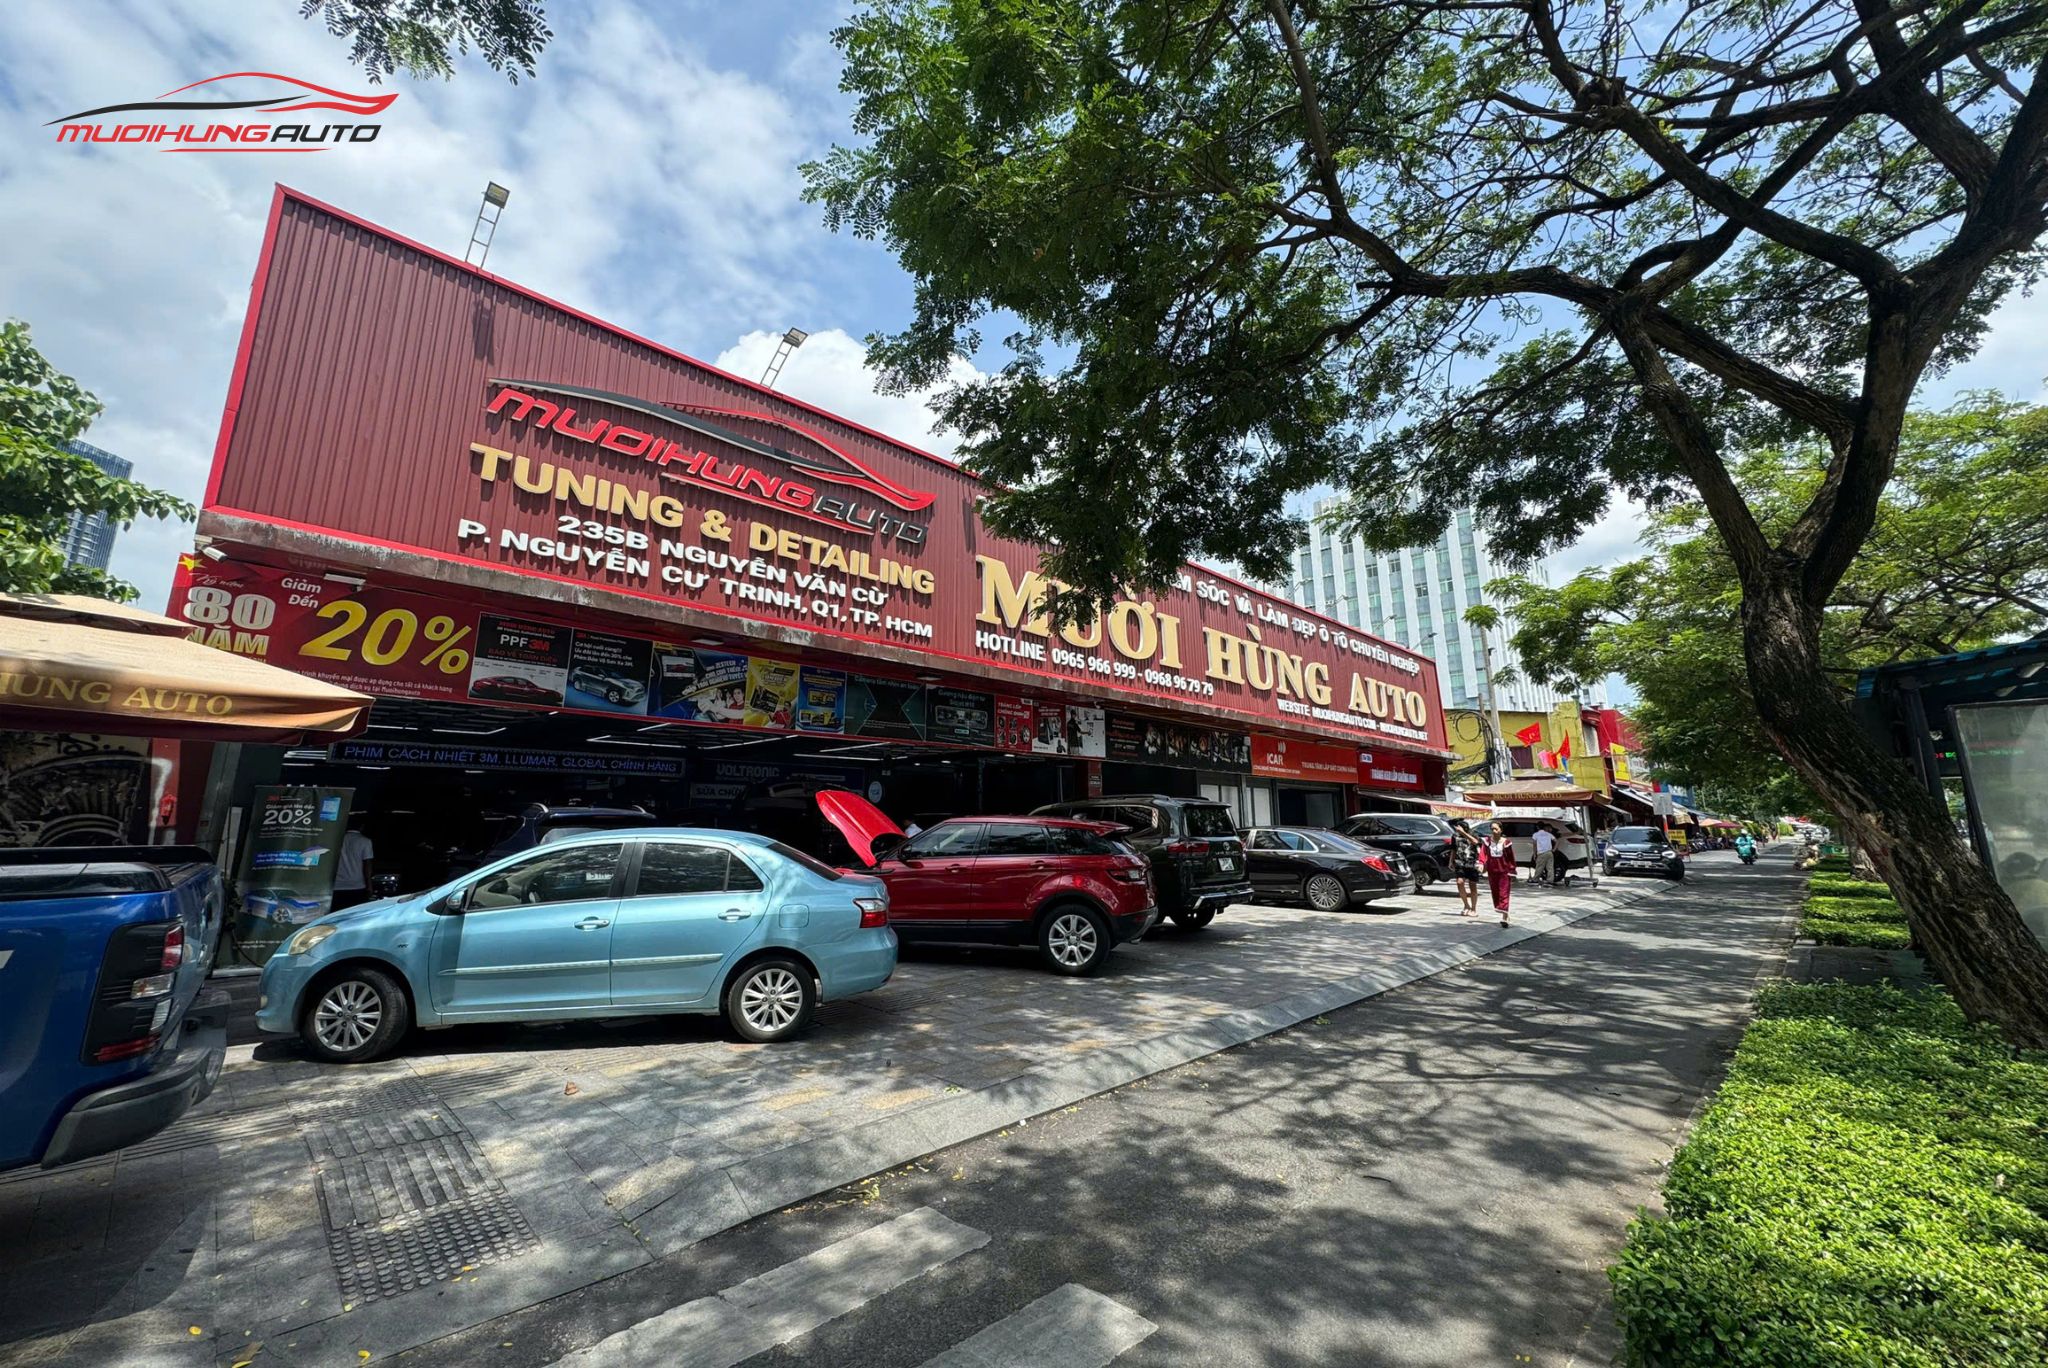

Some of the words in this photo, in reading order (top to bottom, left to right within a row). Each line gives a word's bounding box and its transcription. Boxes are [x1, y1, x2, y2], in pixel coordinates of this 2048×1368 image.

[470, 442, 684, 528] TUNING
[700, 510, 732, 542] &
[750, 522, 935, 594] DETAILING
[457, 518, 491, 543] P.
[500, 529, 650, 577] NGUYỄN
[662, 565, 709, 589] CƯ
[720, 578, 808, 614] TRINH,
[812, 600, 848, 622] Q1,
[850, 607, 881, 627] TP.
[885, 615, 932, 638] HCM
[558, 515, 649, 549] 235B
[660, 539, 786, 584] NGUYỄN
[793, 571, 846, 598] VĂN
[852, 586, 889, 605] CỪ
[281, 577, 322, 593] Giảm
[288, 593, 319, 609] Đến
[183, 586, 276, 630] 80
[1196, 579, 1230, 607] SÓC
[1234, 593, 1254, 616] VÀ
[1257, 602, 1289, 629] LÀM
[1291, 617, 1317, 639] ĐẸP
[1318, 624, 1329, 642] Ô
[1331, 630, 1348, 649] TÔ
[1350, 639, 1389, 664] CHUYÊN
[1390, 654, 1420, 677] NGHIỆP
[299, 600, 472, 674] 20%
[500, 634, 528, 647] PPF
[1052, 648, 1084, 669] 0965
[1088, 656, 1111, 675] 966
[1114, 662, 1136, 680] 999
[1145, 668, 1172, 688] 0968
[1203, 622, 1331, 706] HÙNG
[1348, 672, 1427, 727] AUTO
[121, 686, 233, 715] AUTO
[344, 745, 383, 759] PHIM
[562, 756, 609, 770] GLOBAL
[1266, 753, 1284, 766] ICAR
[263, 809, 314, 825] 20%
